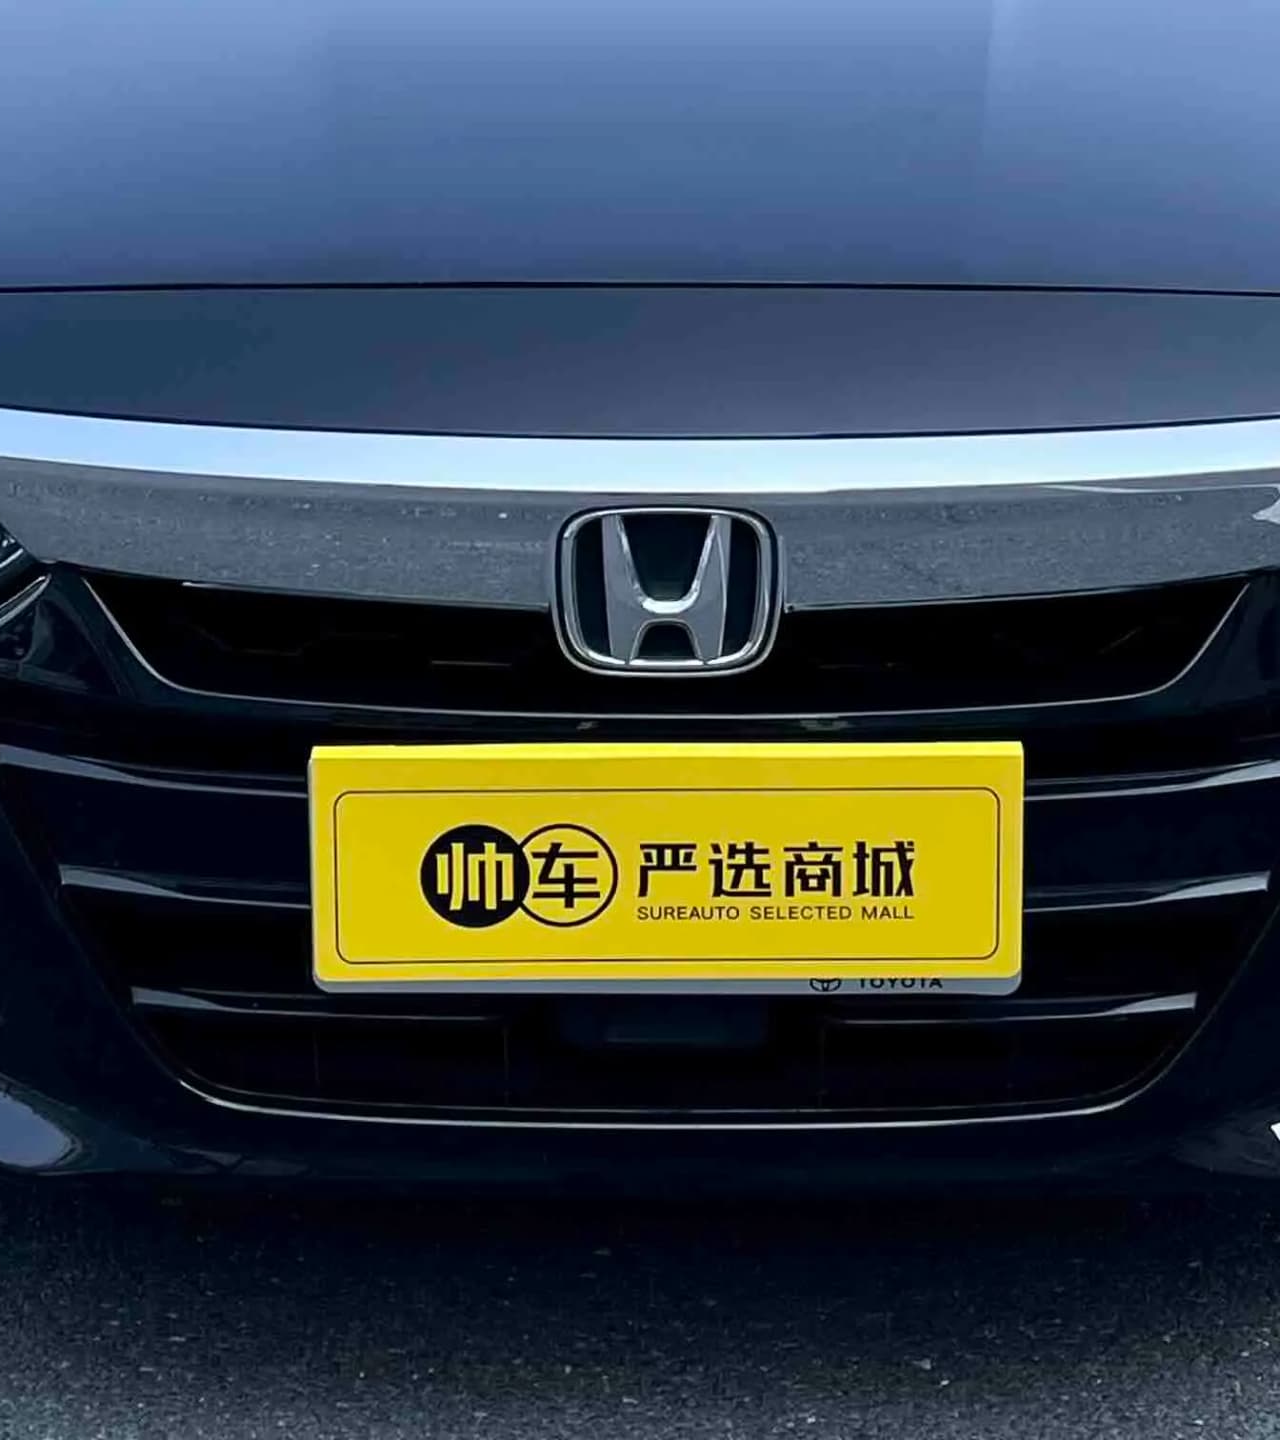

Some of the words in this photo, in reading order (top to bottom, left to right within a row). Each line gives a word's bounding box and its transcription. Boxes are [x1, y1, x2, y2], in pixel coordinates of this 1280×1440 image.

[637, 840, 915, 898] 严选商城
[637, 905, 740, 921] SUREAUTO
[750, 905, 852, 920] SELECTED
[861, 905, 914, 920] MALL
